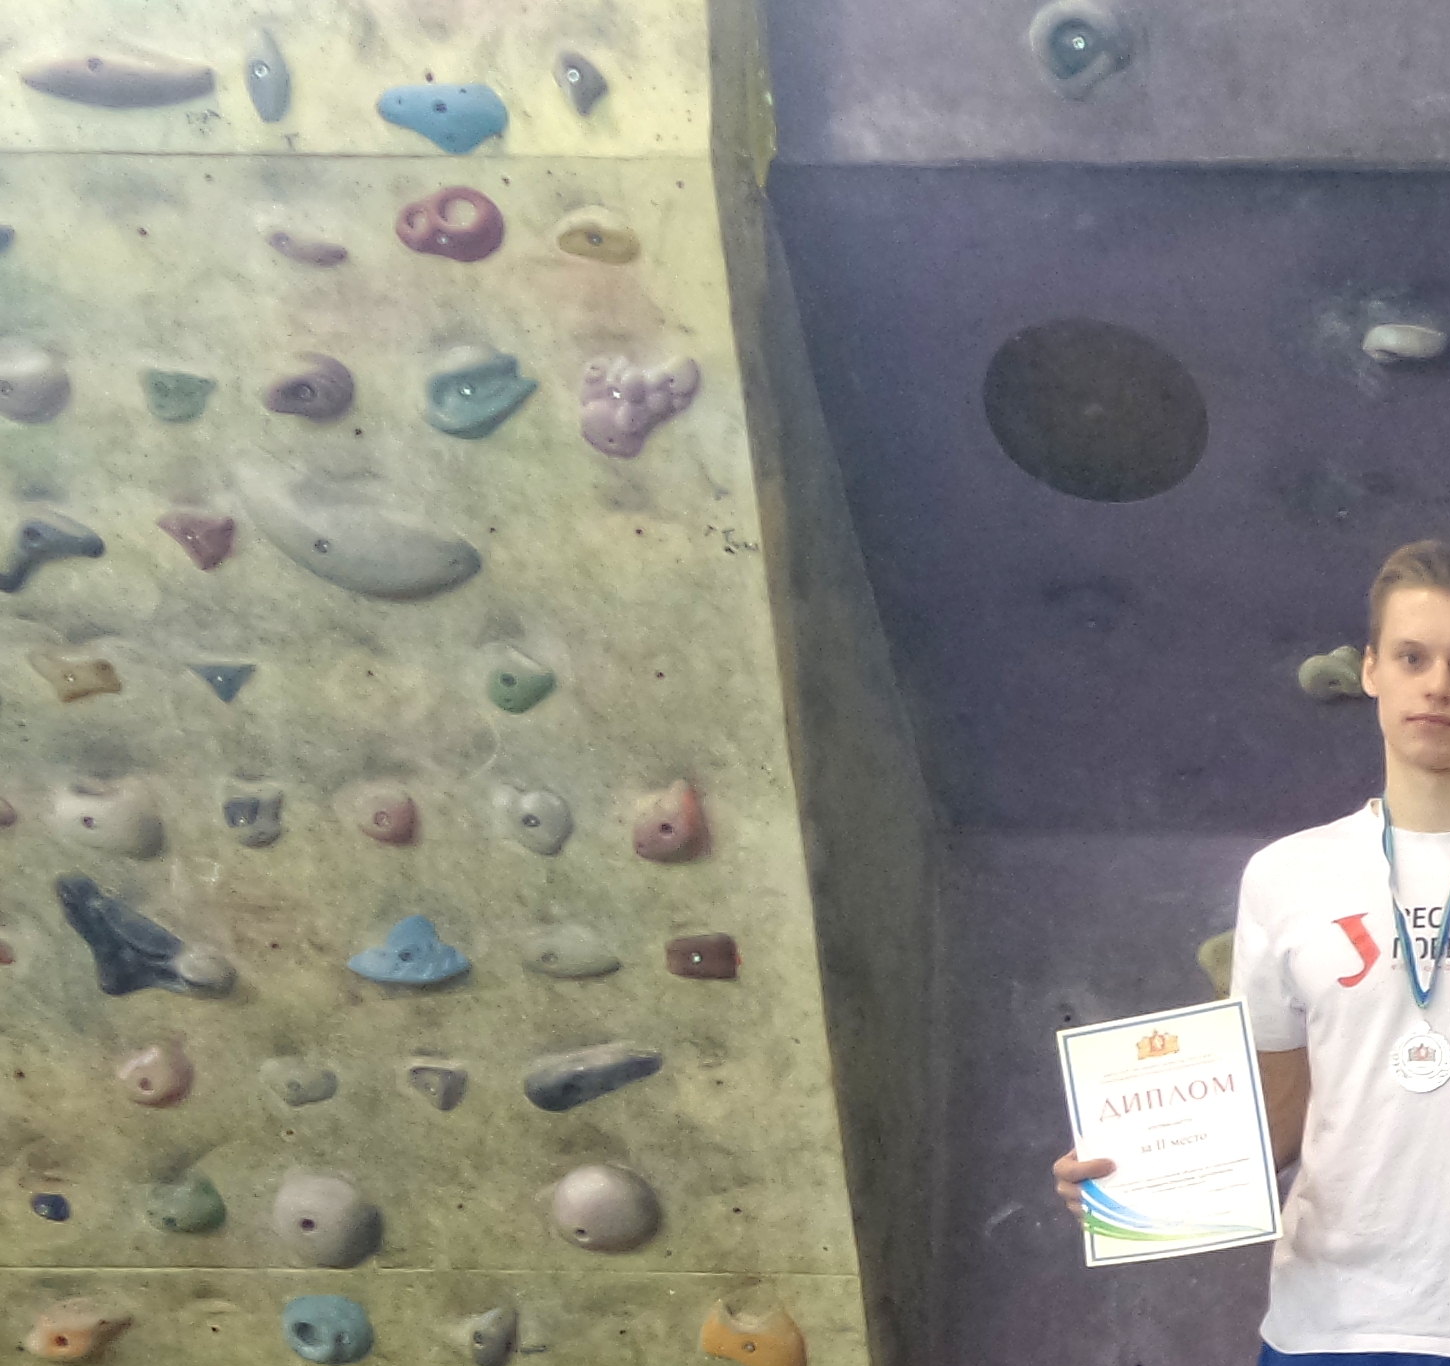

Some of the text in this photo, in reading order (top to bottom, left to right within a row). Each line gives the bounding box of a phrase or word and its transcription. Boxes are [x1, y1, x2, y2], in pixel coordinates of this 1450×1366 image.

[1099, 1073, 1235, 1122] ДИПЛОМ
[1156, 1138, 1166, 1151] II
[1170, 1132, 1208, 1147] место
